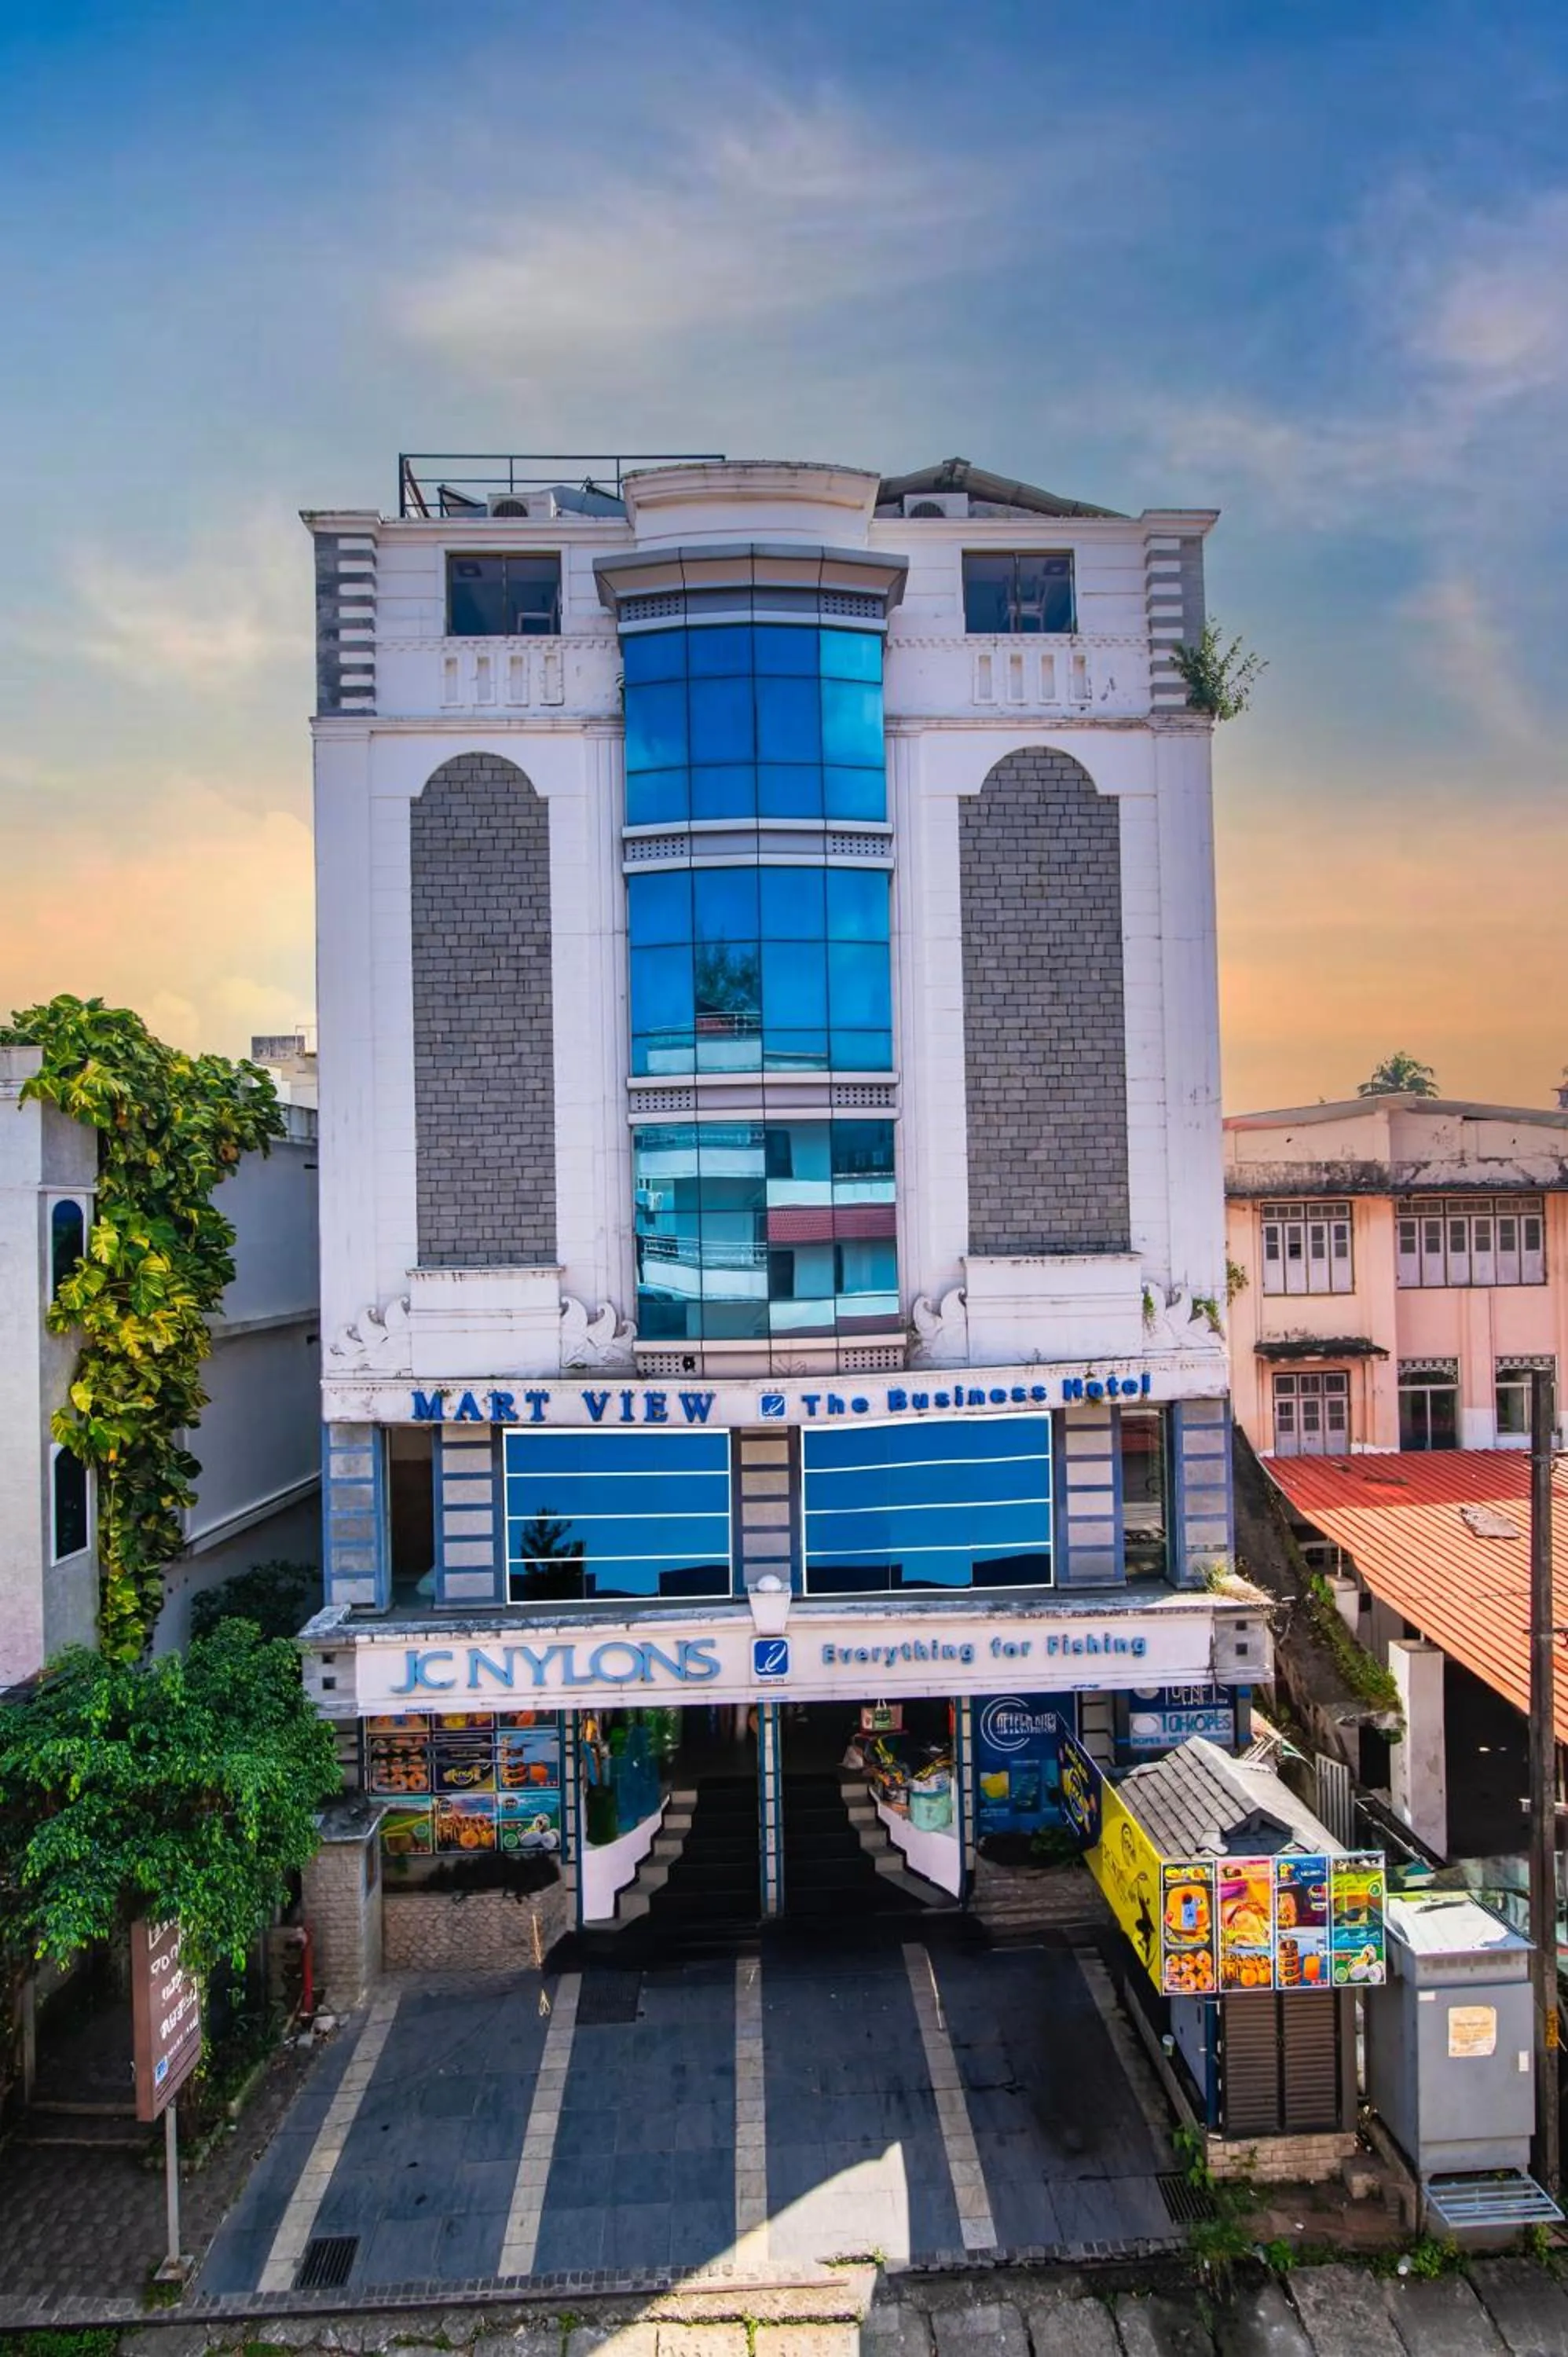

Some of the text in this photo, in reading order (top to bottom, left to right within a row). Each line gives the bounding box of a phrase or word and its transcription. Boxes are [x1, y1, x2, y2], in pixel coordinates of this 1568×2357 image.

[411, 1389, 716, 1424] MART VIEW
[800, 1373, 1152, 1417] The Business Hotel
[390, 1638, 722, 1695] JC NYLONS
[822, 1633, 1146, 1667] Everything for Fishing
